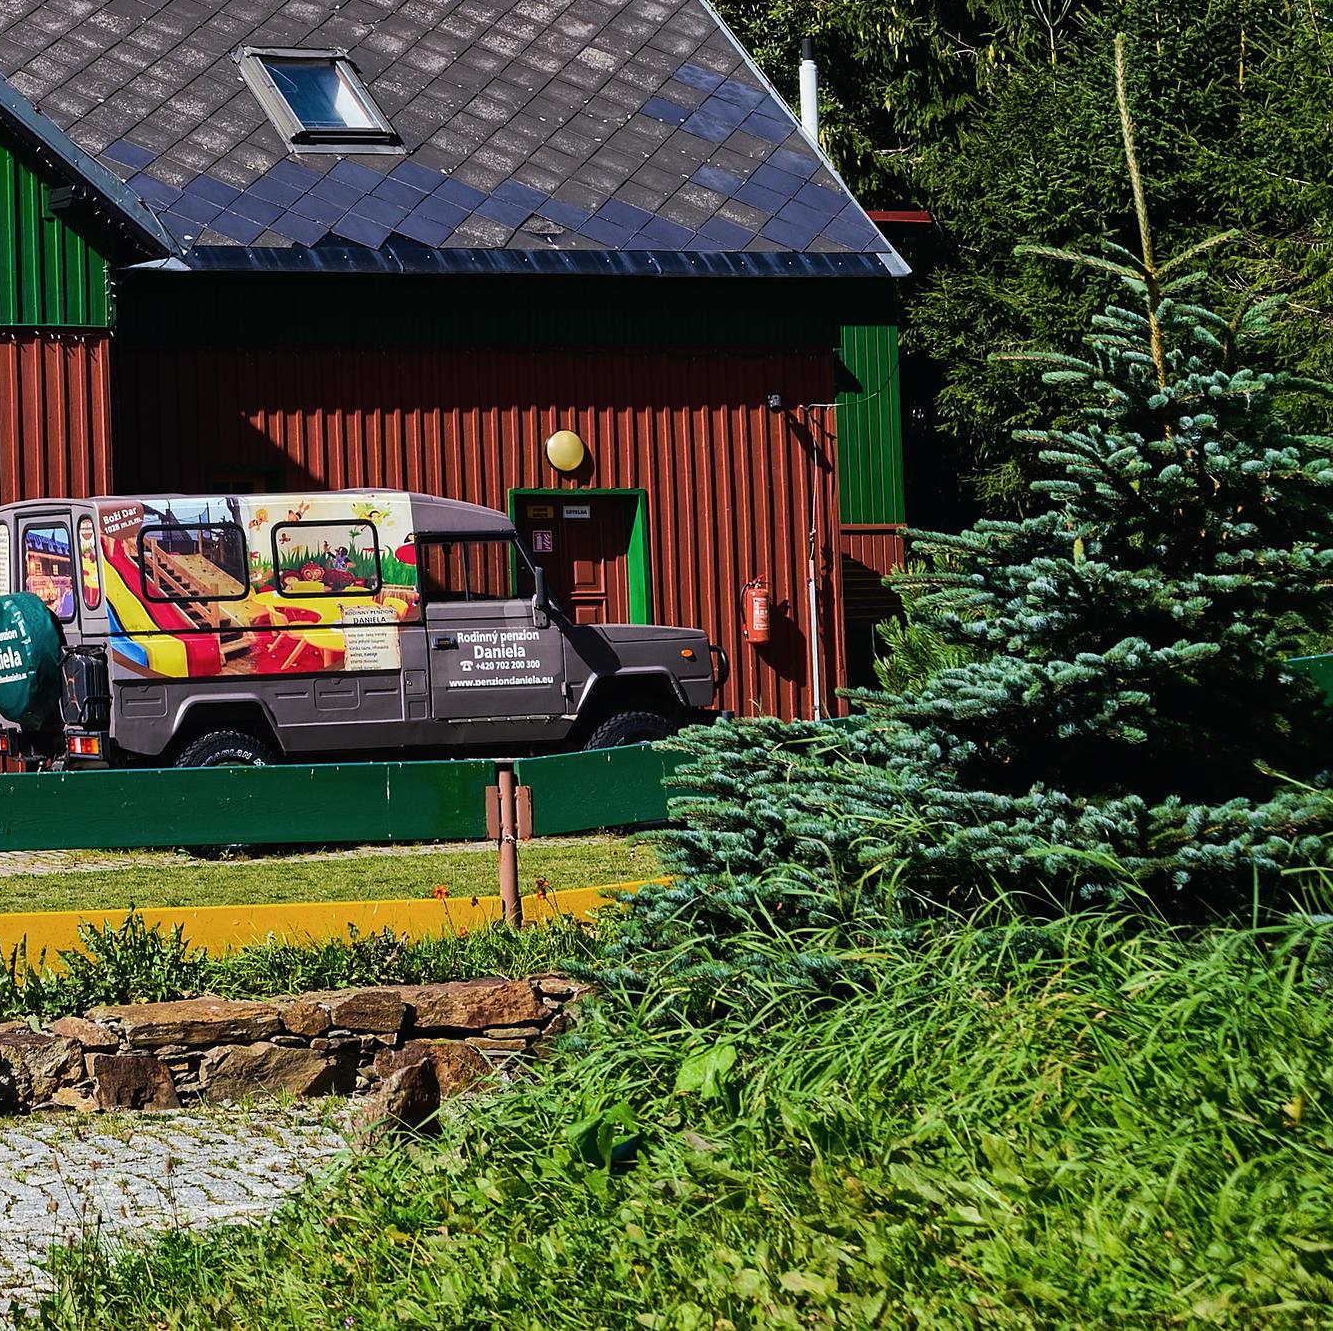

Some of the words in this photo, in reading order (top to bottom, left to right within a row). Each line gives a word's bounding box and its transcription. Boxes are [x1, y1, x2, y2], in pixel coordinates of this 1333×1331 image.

[103, 511, 121, 524] Boží
[121, 507, 137, 518] Dar
[353, 616, 387, 624] DANIELA
[457, 630, 498, 644] Rodinný
[500, 629, 539, 643] penzion
[473, 643, 526, 659] Daniela
[475, 662, 495, 670] +420
[495, 661, 510, 670] 702
[511, 660, 525, 668] 200
[526, 660, 540, 668] 300
[449, 675, 553, 687] www.penziondaniela.eu
